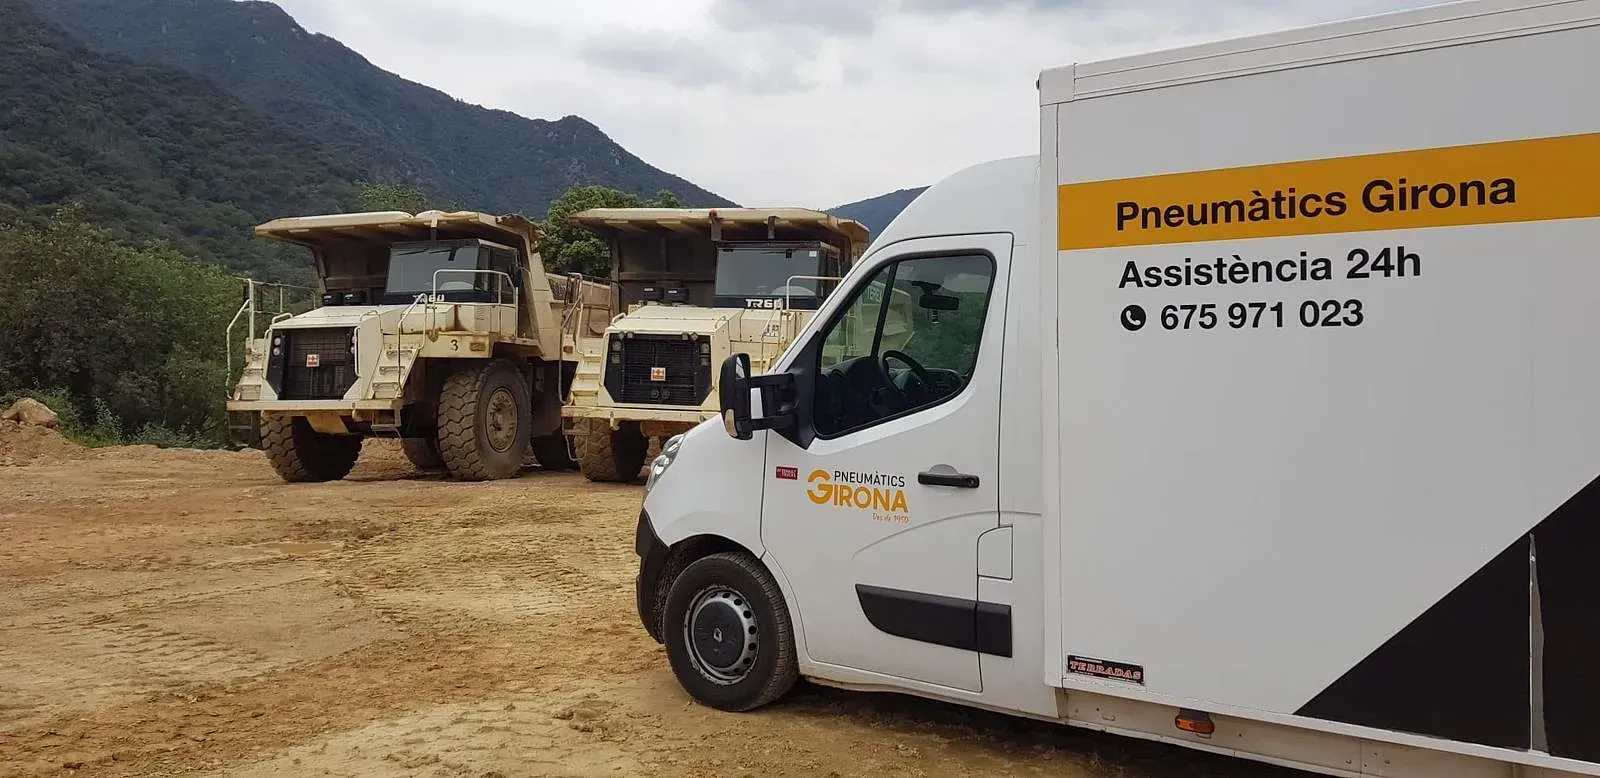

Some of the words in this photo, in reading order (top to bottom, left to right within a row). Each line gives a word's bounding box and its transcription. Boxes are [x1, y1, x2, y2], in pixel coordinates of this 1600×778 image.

[1116, 187, 1347, 231] Pneumàtics
[1362, 177, 1516, 213] Girona
[1118, 251, 1332, 288] Assistència
[1346, 246, 1421, 279] 24h
[1160, 303, 1218, 330] 675
[1227, 301, 1283, 328] 971
[1299, 299, 1364, 328] 023
[806, 469, 909, 513] GIRONA
[833, 470, 905, 487] PNEUMÀTICS
[1070, 661, 1141, 679] TERRADAS
